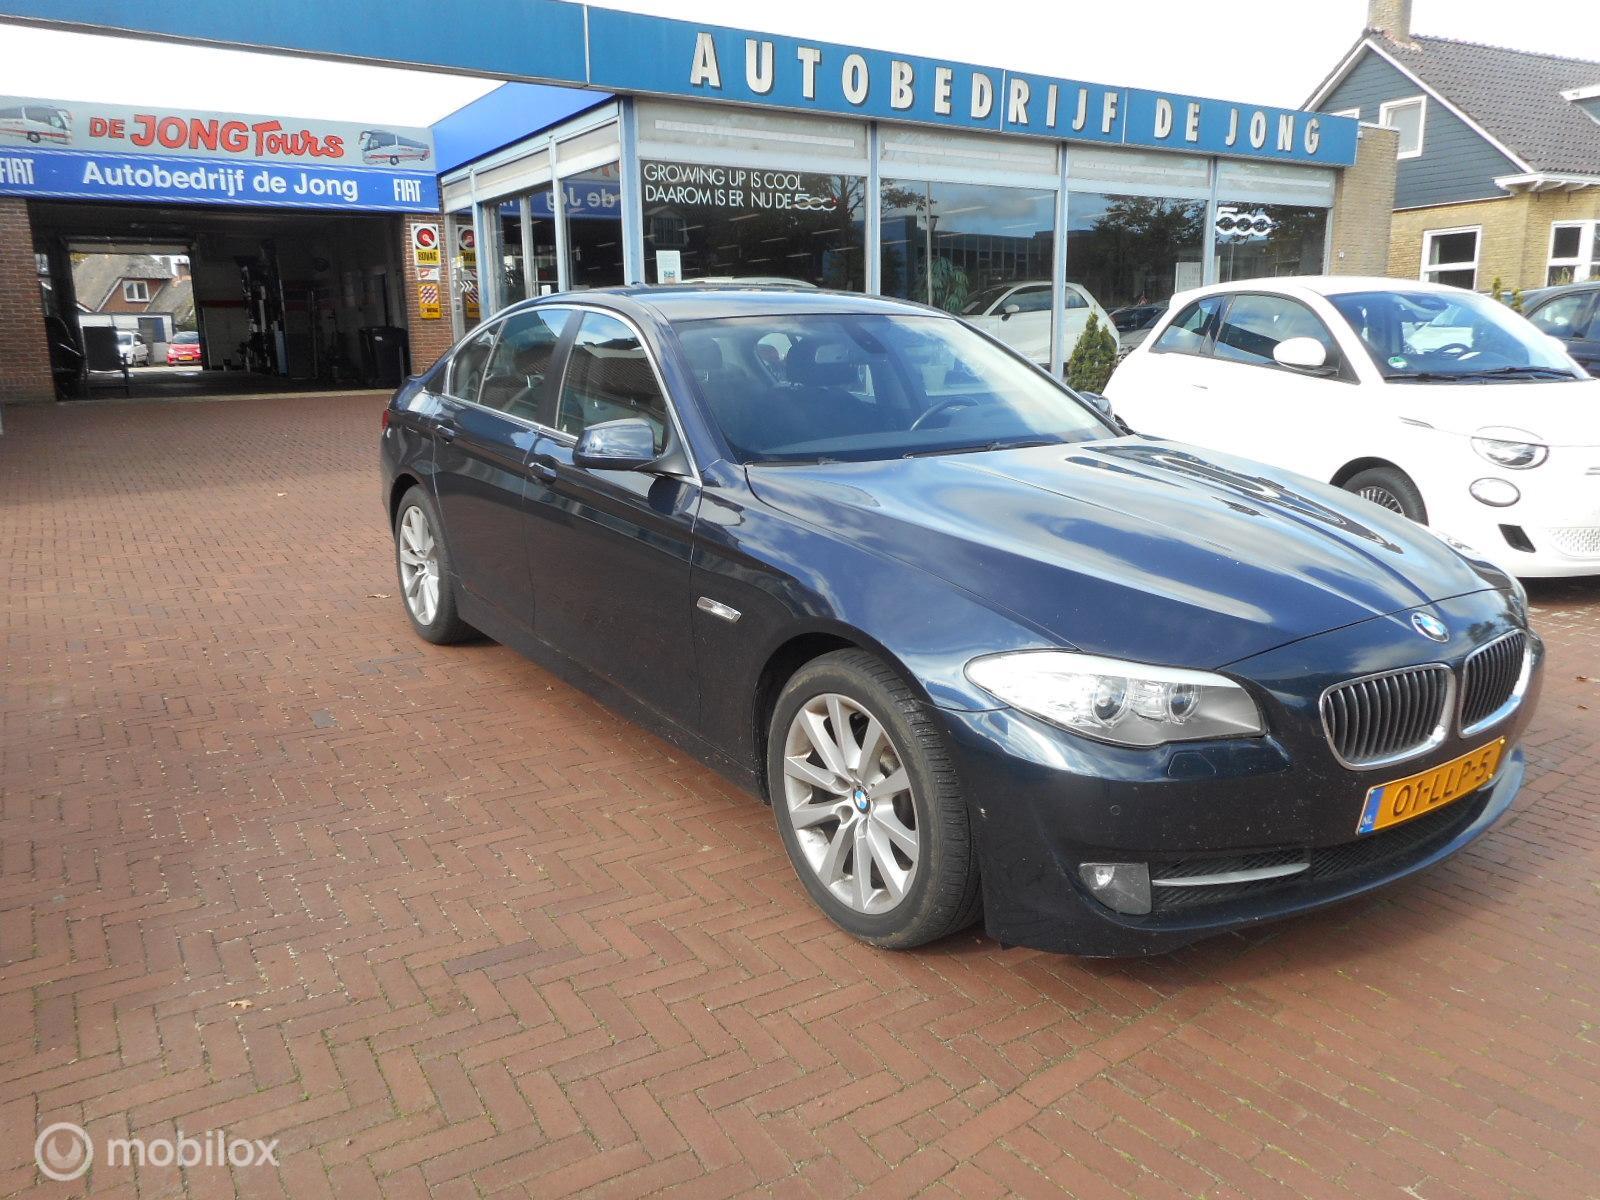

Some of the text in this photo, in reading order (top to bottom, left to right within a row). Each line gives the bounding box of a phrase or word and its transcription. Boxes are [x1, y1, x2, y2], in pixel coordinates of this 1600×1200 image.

[690, 32, 1320, 154] AUTOBEDRIJF DE JONG
[89, 114, 344, 158] DE JONG Tours
[0, 157, 35, 185] FIAT
[83, 161, 358, 202] Autobedrijf de Jong
[644, 164, 805, 191] GROWING UP IS COOL.
[393, 178, 421, 202] FIAT
[645, 185, 711, 205] DAAROM
[715, 189, 725, 206] IS
[730, 190, 744, 208] ER
[751, 192, 772, 209] NU
[776, 193, 791, 209] DE
[1216, 206, 1272, 236] 500
[1393, 751, 1491, 817] 01-LLP-5
